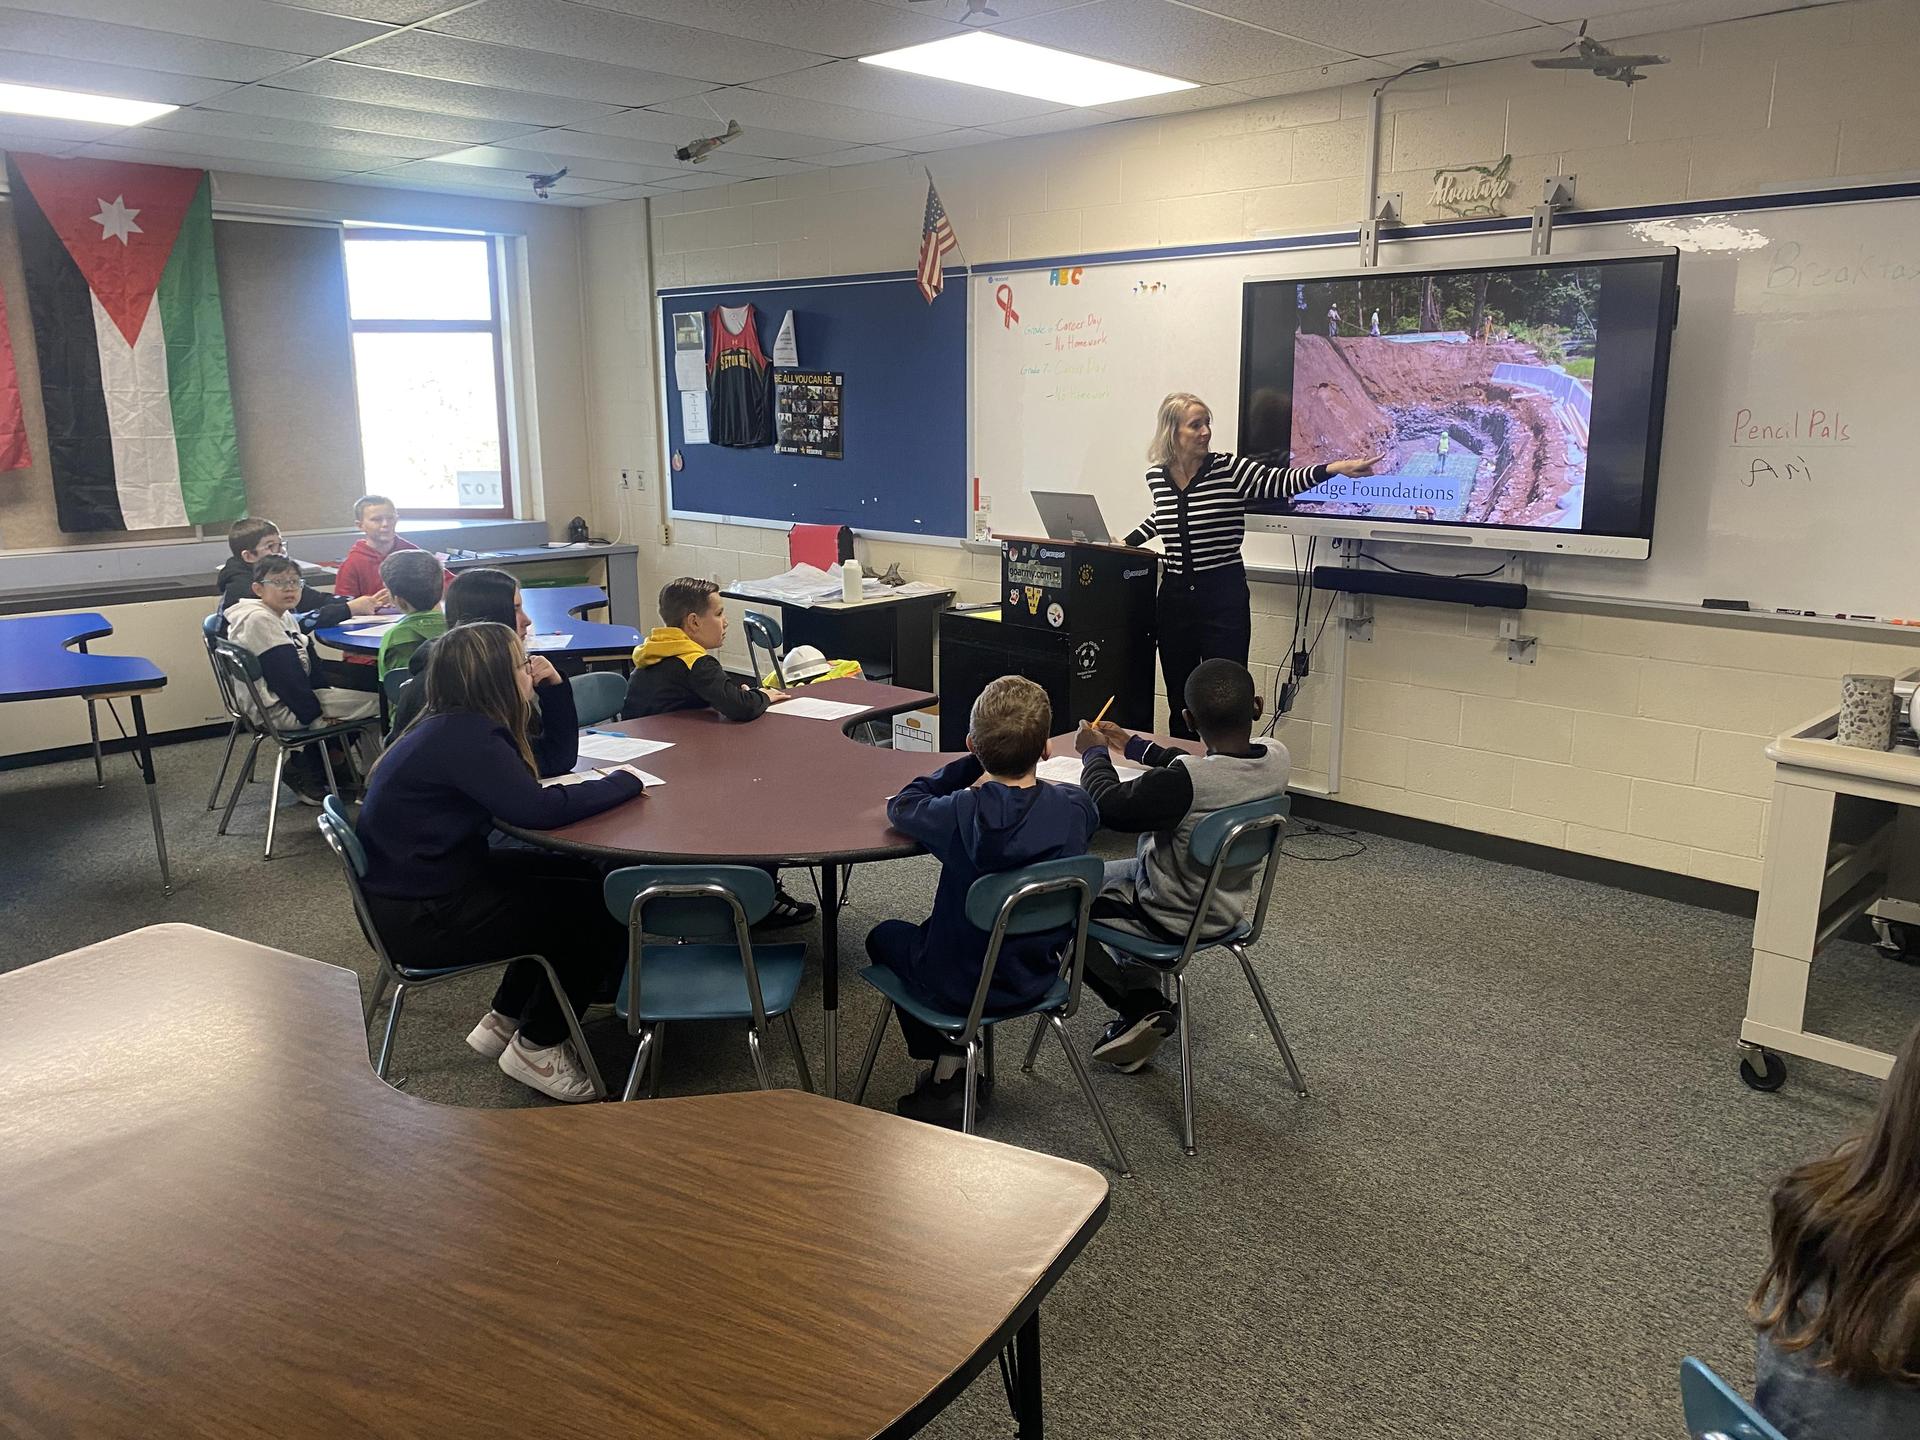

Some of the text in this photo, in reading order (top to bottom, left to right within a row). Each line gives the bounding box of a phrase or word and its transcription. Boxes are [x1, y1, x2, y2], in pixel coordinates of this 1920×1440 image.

[1056, 318, 1084, 331] Career
[1087, 313, 1102, 332] Day
[1068, 331, 1107, 349] Homework
[774, 375, 783, 383] BE
[783, 374, 795, 383] ALL
[794, 375, 808, 384] YOU
[808, 375, 822, 384] CAN
[1734, 408, 1851, 443] Pencil Pals
[1308, 480, 1454, 500] idge Foundations
[1010, 568, 1051, 580] goarmy.com
